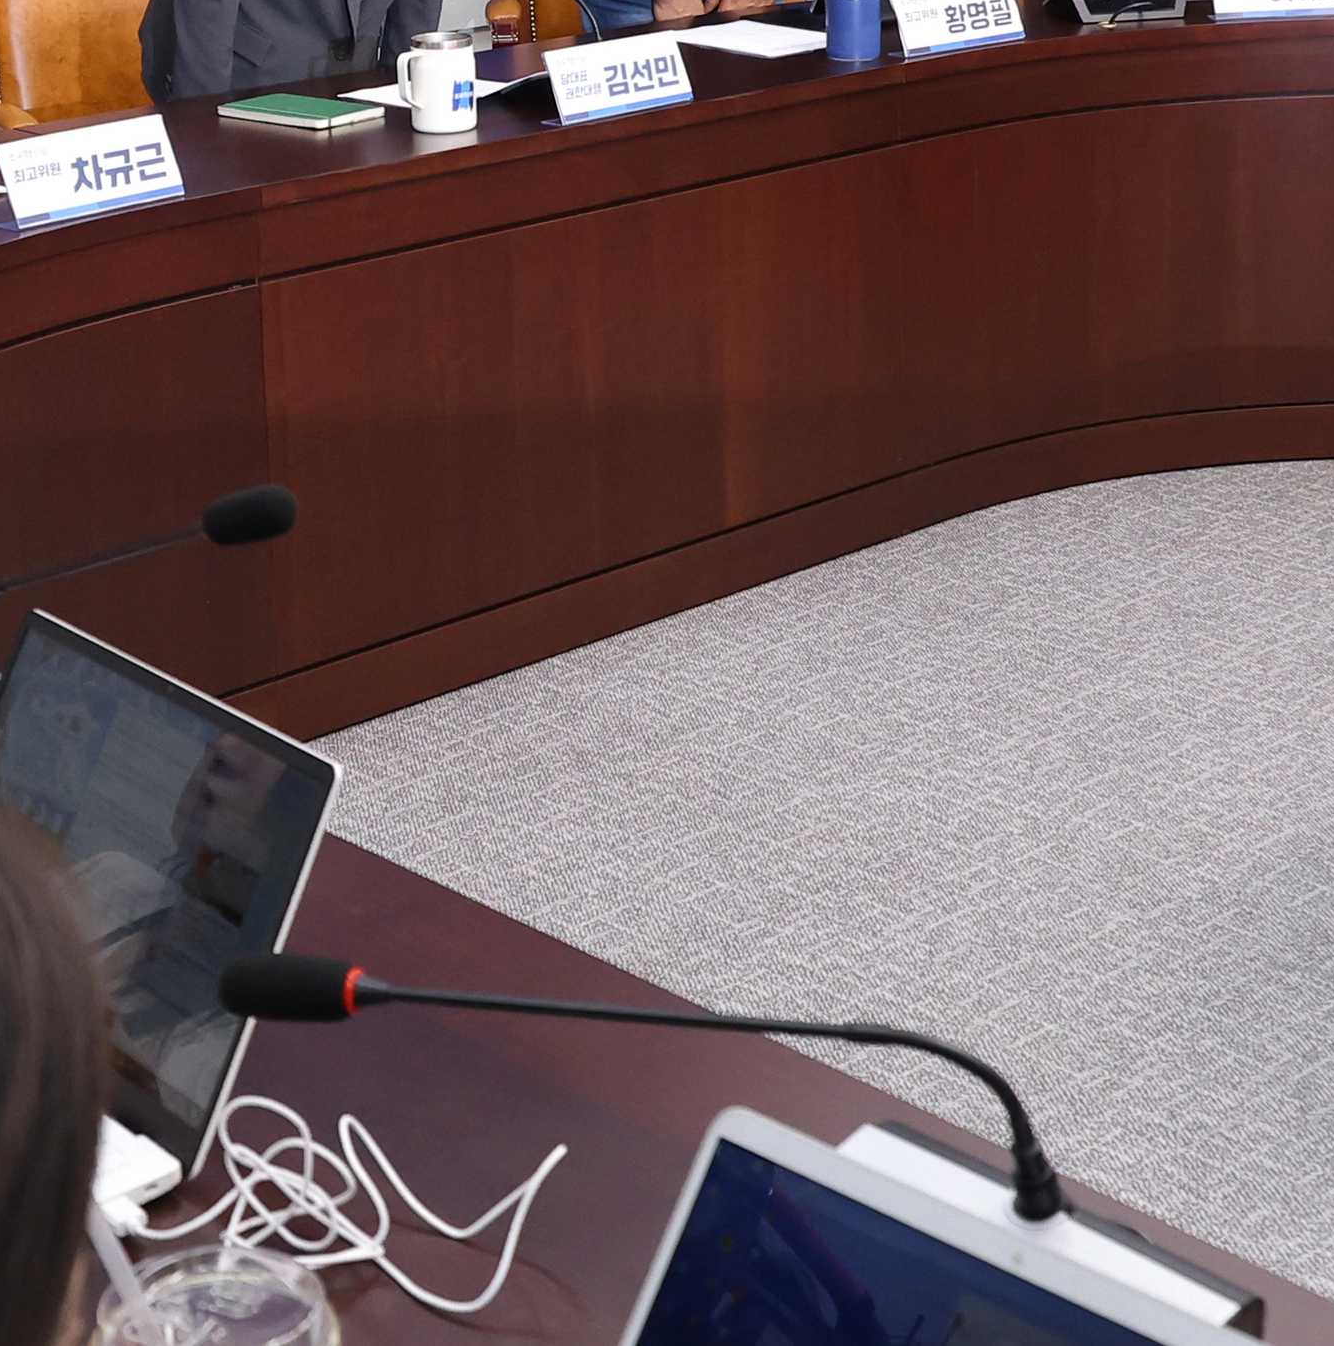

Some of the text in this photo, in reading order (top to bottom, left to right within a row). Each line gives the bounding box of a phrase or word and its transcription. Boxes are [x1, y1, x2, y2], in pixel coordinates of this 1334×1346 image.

[905, 9, 938, 23] 최고위원
[560, 70, 588, 86] 당대표
[603, 54, 680, 97] 김선민
[565, 83, 602, 100] 권한대행
[13, 162, 61, 184] 최고위원
[70, 141, 168, 193] 차규근
